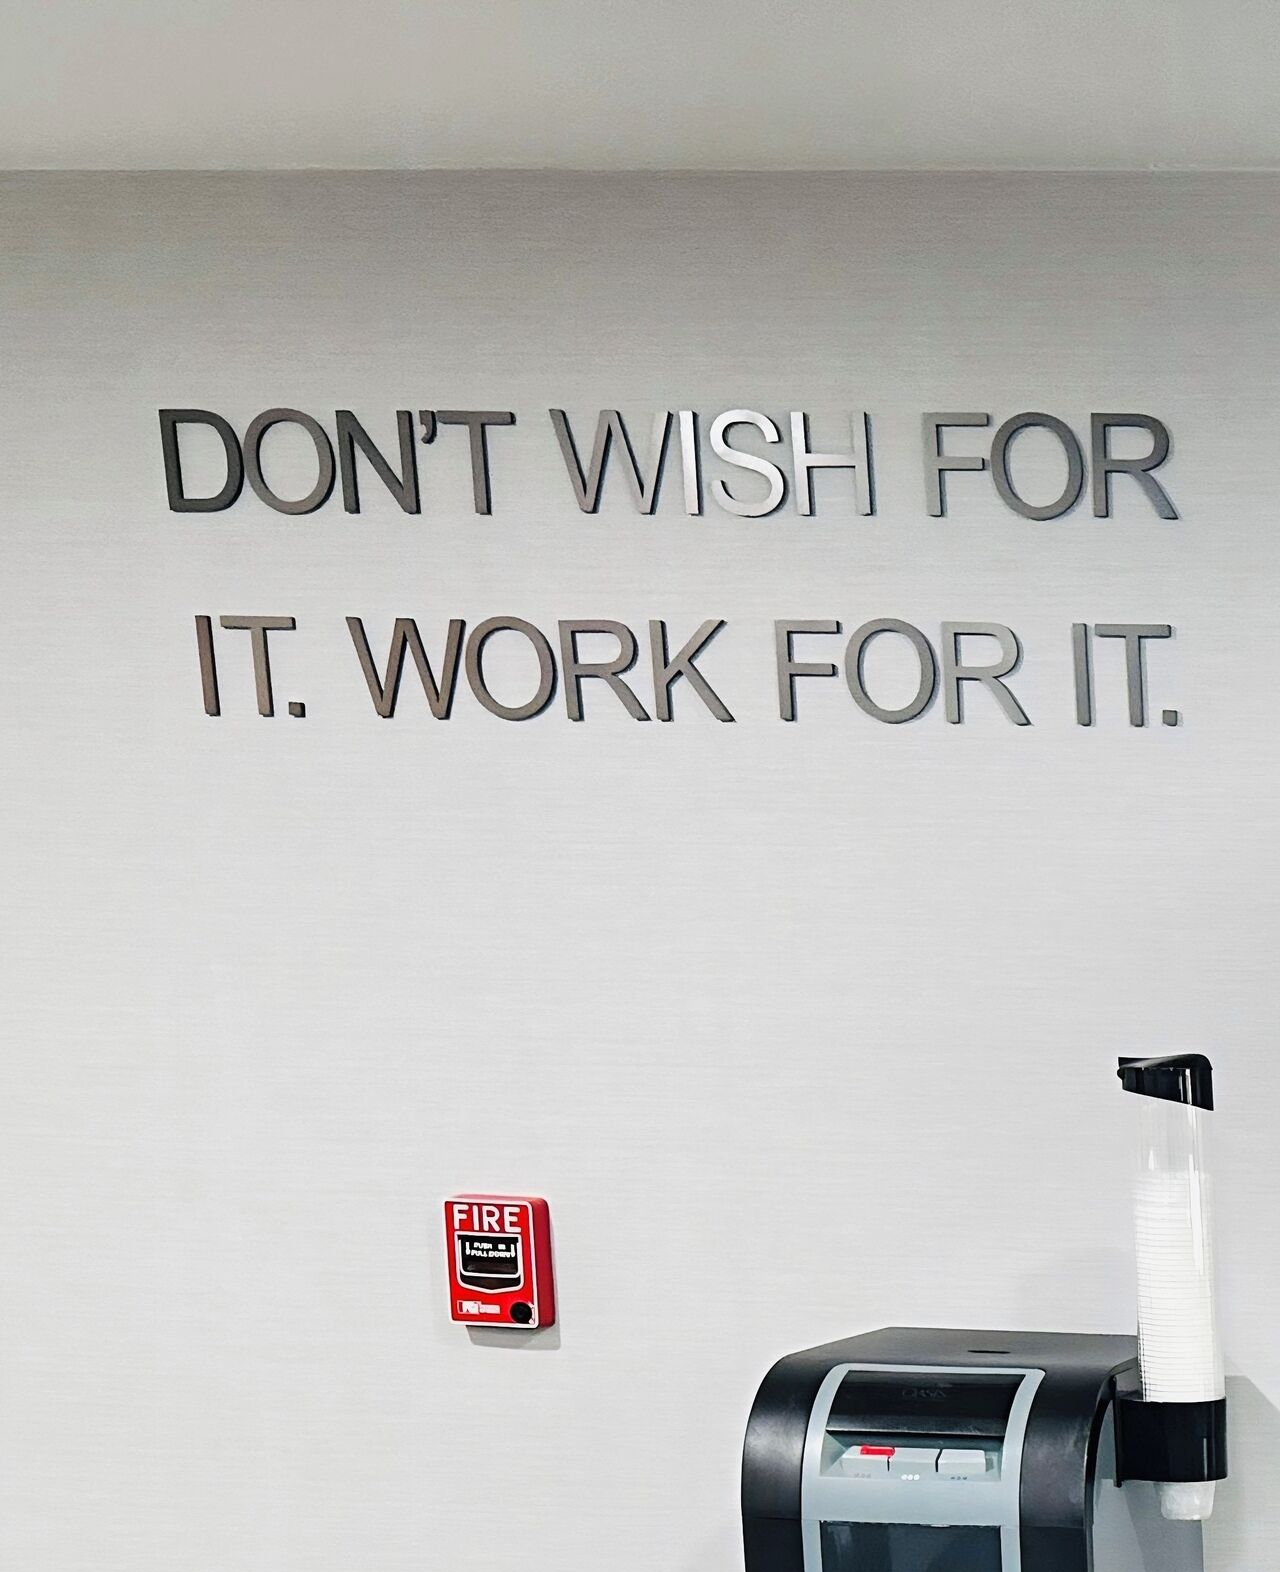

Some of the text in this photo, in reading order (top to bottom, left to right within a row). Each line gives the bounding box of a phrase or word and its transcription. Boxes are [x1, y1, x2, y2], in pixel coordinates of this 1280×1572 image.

[158, 408, 1181, 522] DON'T WISH FOR
[195, 614, 1181, 727] IT. WORK FOR IT.
[452, 1203, 522, 1233] FIRE
